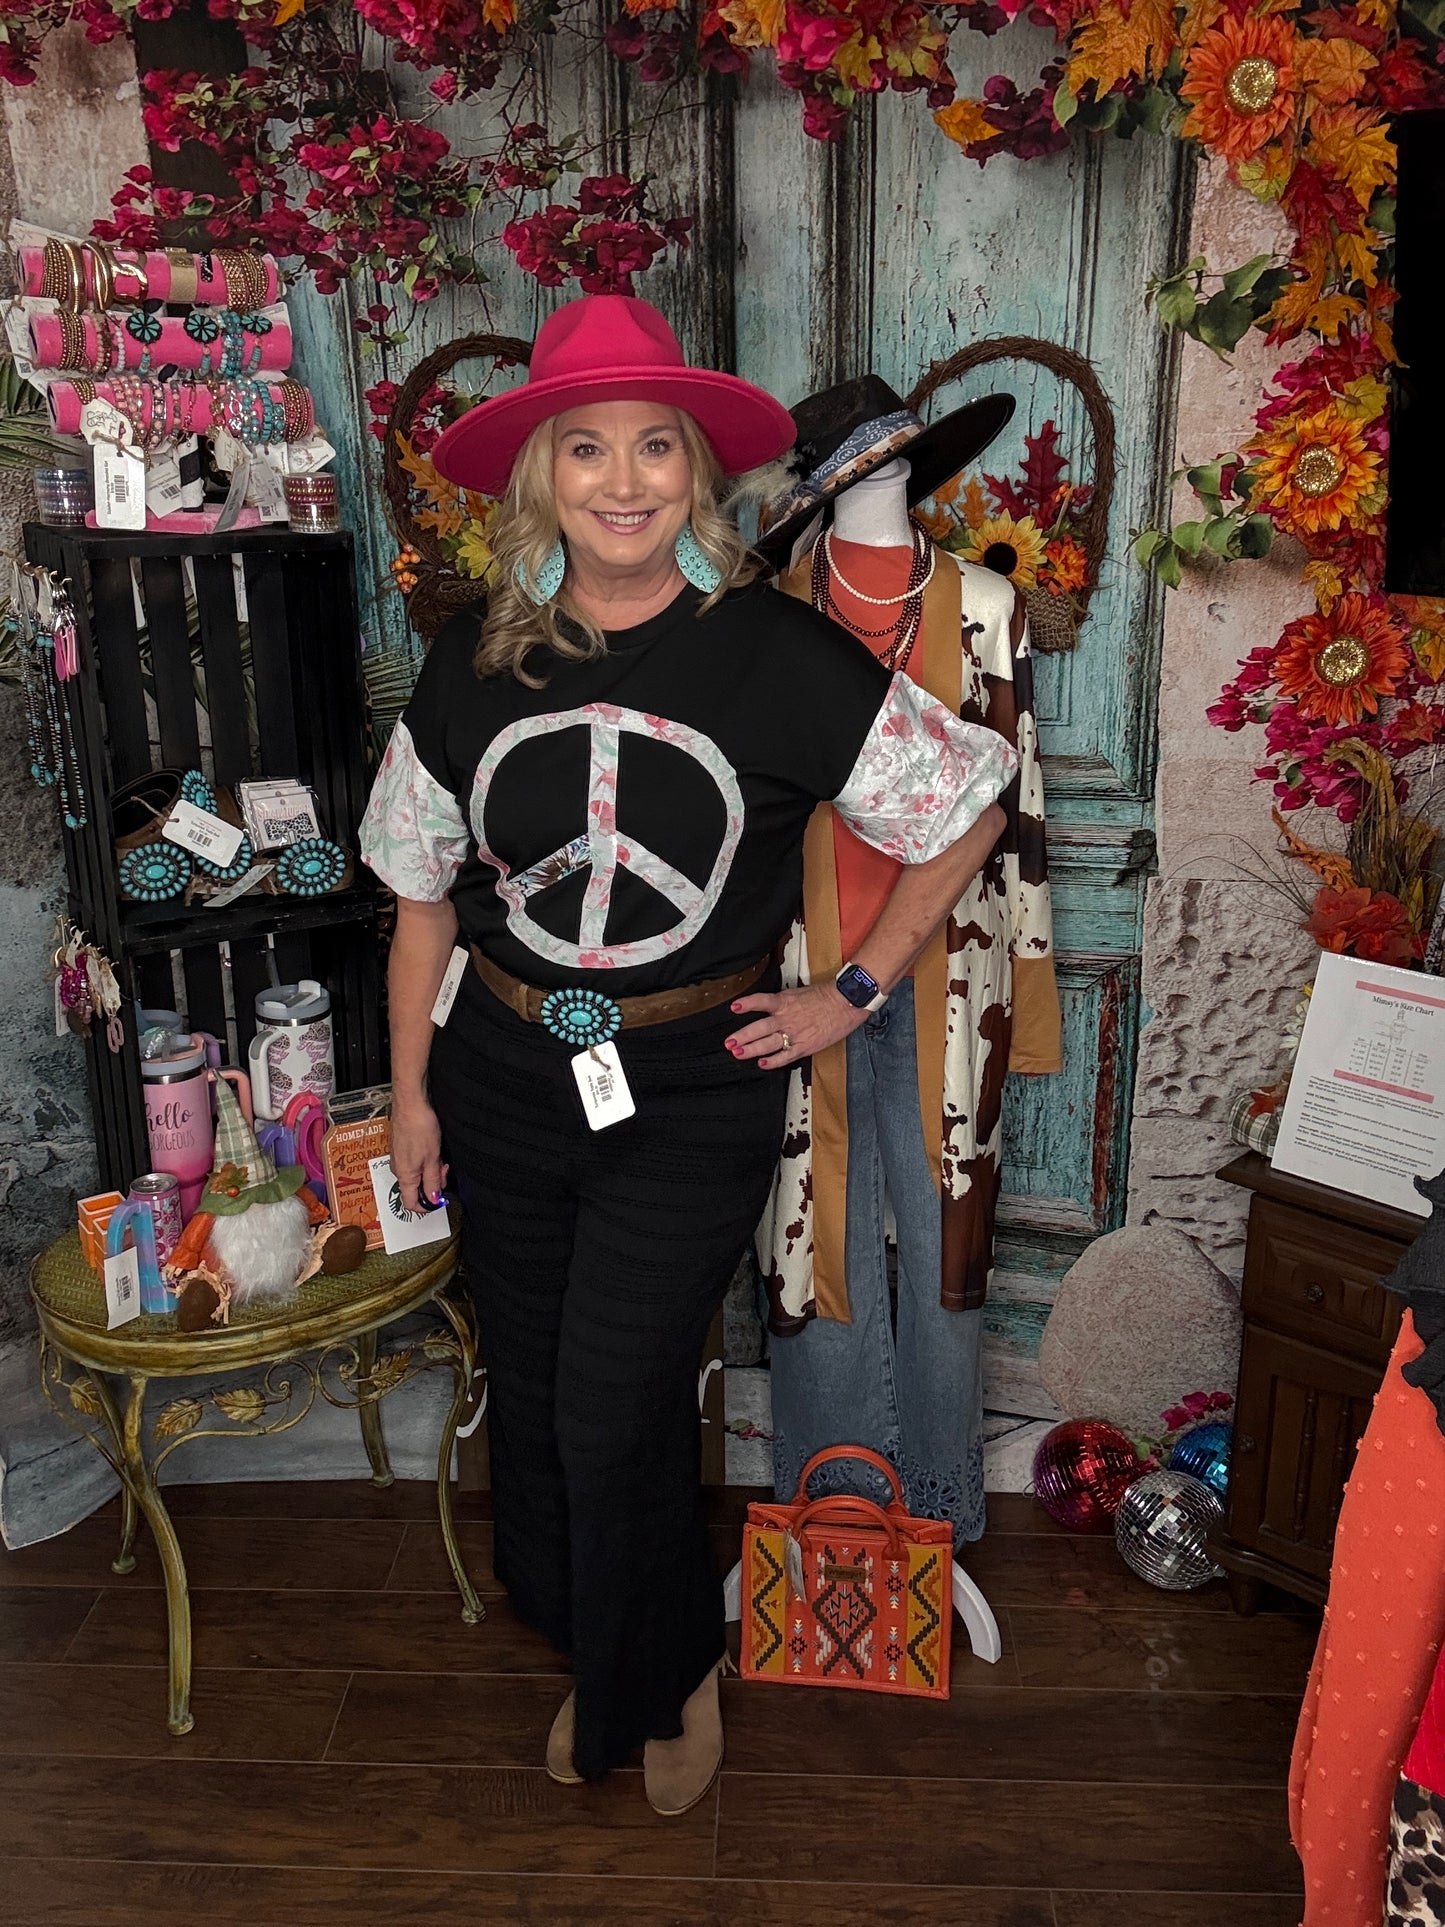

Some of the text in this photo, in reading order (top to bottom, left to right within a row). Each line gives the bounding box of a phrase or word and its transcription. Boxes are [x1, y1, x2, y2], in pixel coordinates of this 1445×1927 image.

[1399, 1002, 1415, 1011] Size
[1414, 1005, 1435, 1017] Chart
[145, 1101, 194, 1132] hello
[346, 1158, 370, 1177] grou
[339, 1185, 362, 1198] brown
[340, 1193, 376, 1214] pump
